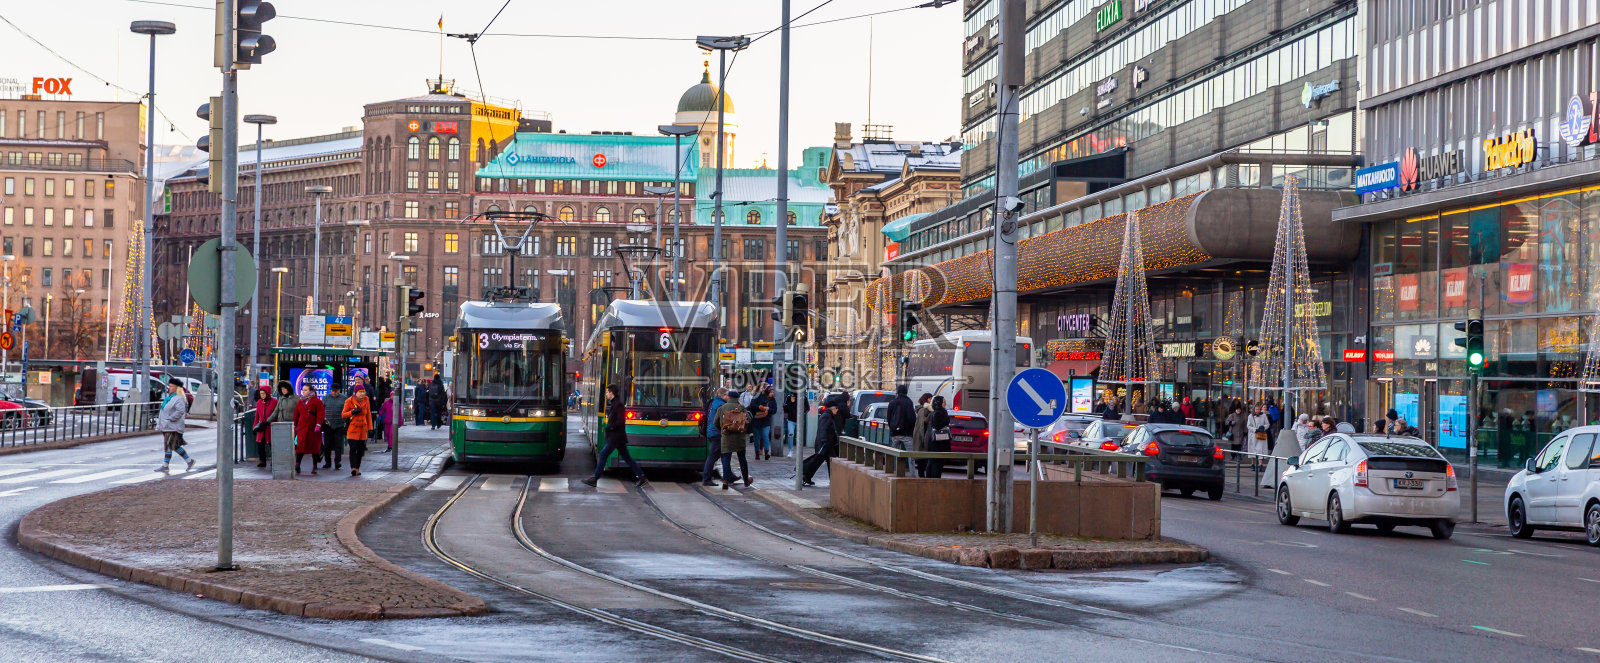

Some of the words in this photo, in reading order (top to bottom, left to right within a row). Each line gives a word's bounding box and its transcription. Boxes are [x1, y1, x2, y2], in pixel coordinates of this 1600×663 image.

[33, 77, 72, 95] FOX
[1589, 92, 1600, 143] Z
[1515, 128, 1533, 163] Pub
[521, 155, 575, 164] LÄHITAPIOLA
[1420, 149, 1461, 181] HUAWEI
[1357, 168, 1395, 188] MATKAHUOLTO
[1057, 314, 1090, 331] CITYCENTER
[479, 333, 490, 348] 3
[660, 332, 670, 350] 6
